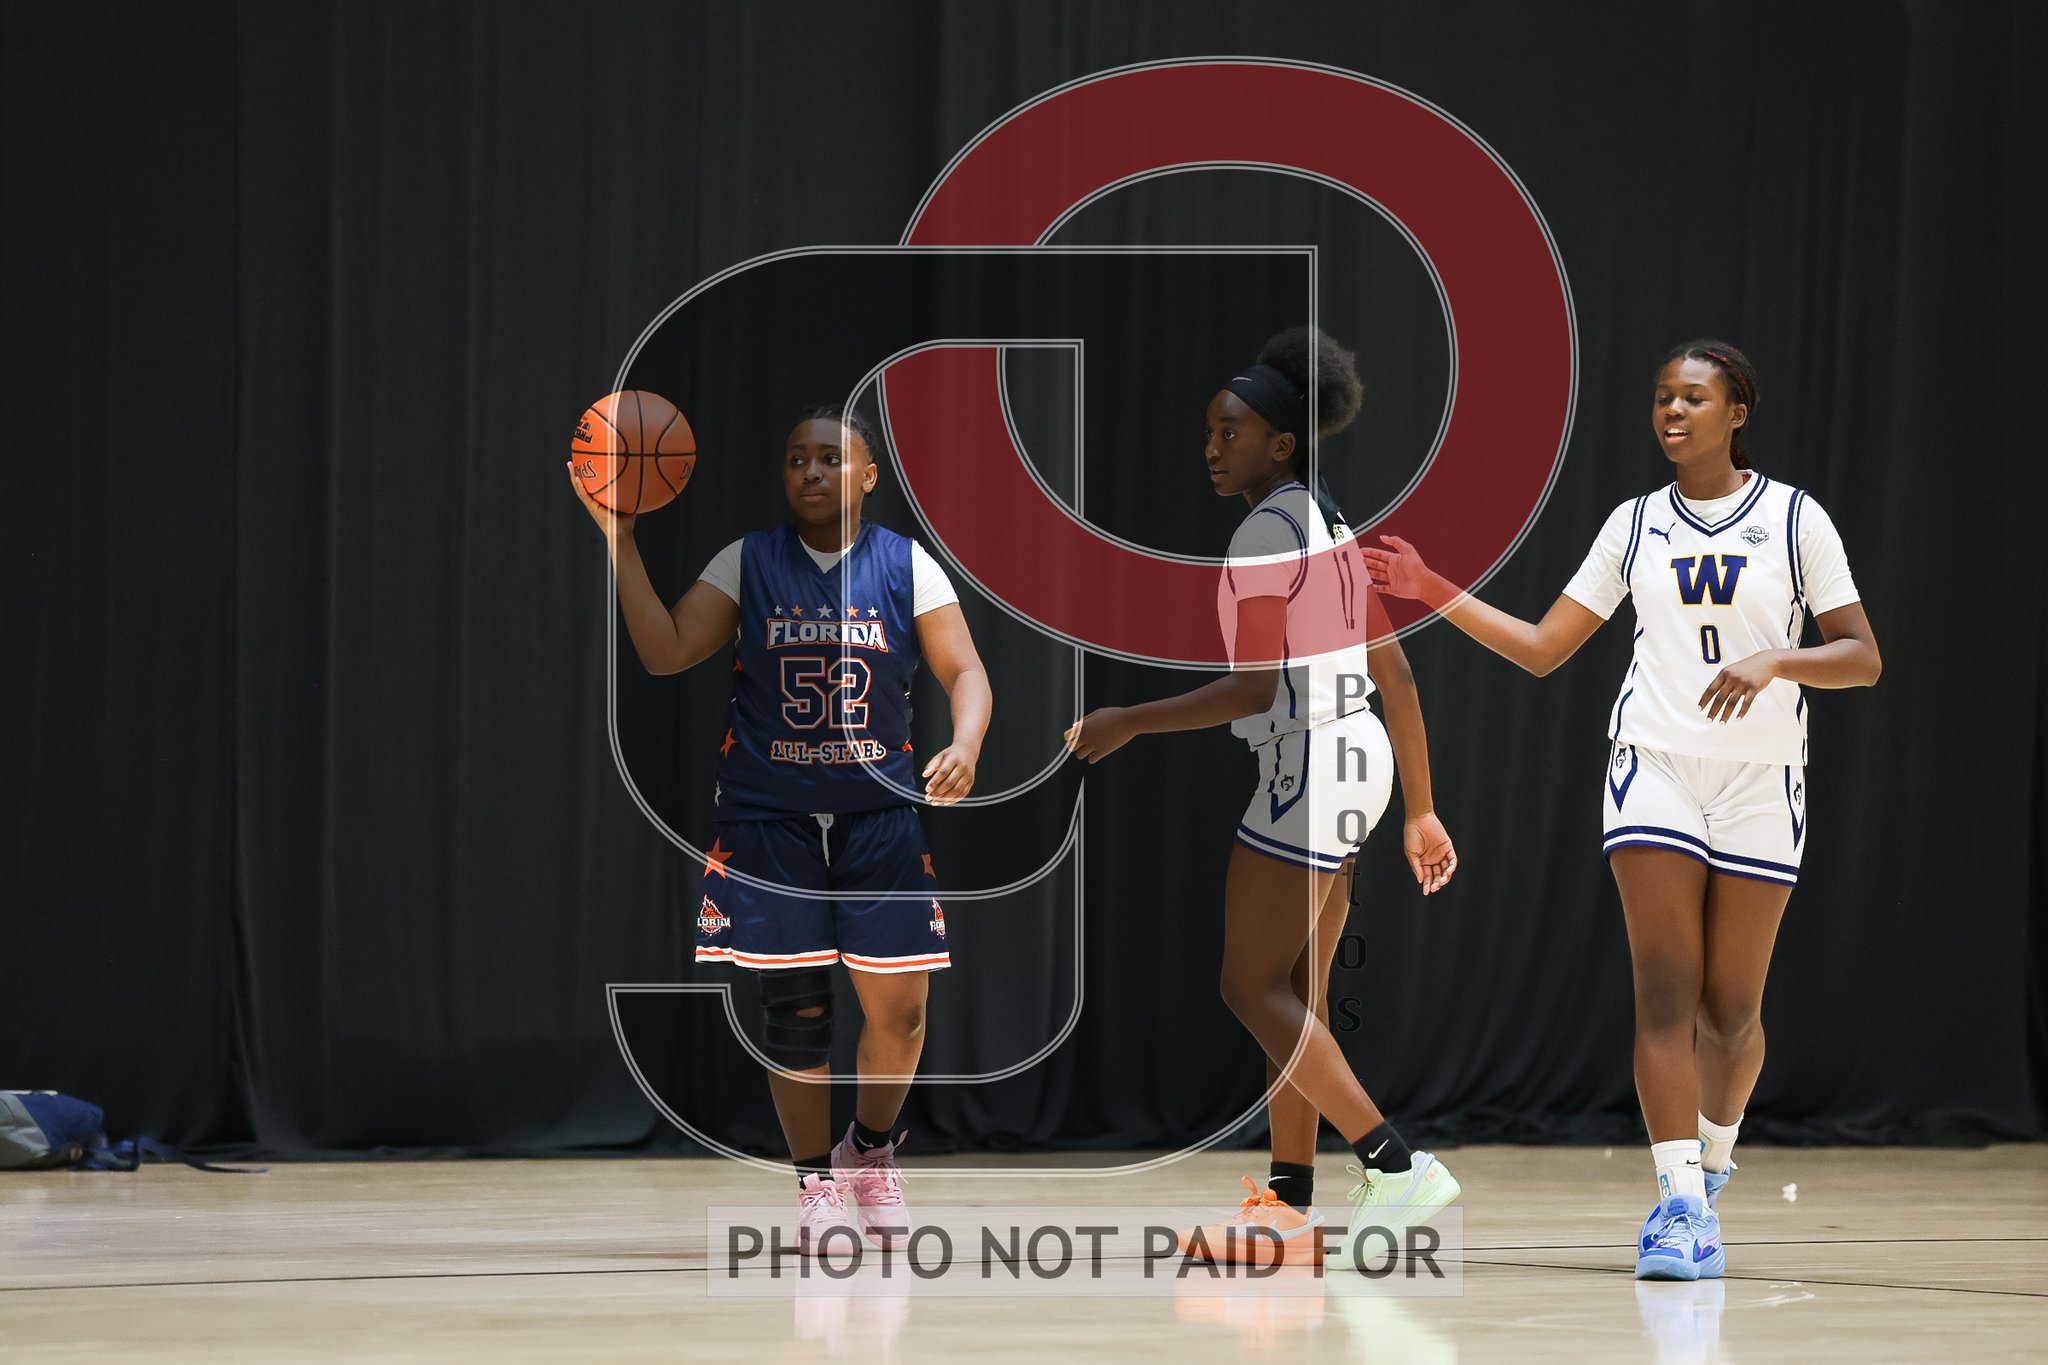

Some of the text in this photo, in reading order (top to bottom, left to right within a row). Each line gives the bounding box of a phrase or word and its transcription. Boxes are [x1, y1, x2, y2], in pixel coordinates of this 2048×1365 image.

[1669, 553, 1748, 607] W
[767, 618, 889, 652] FLORIDA
[1698, 623, 1723, 665] 0
[780, 656, 872, 730] 52
[771, 740, 887, 765] ALL-STARS
[697, 917, 731, 928] LORIDA
